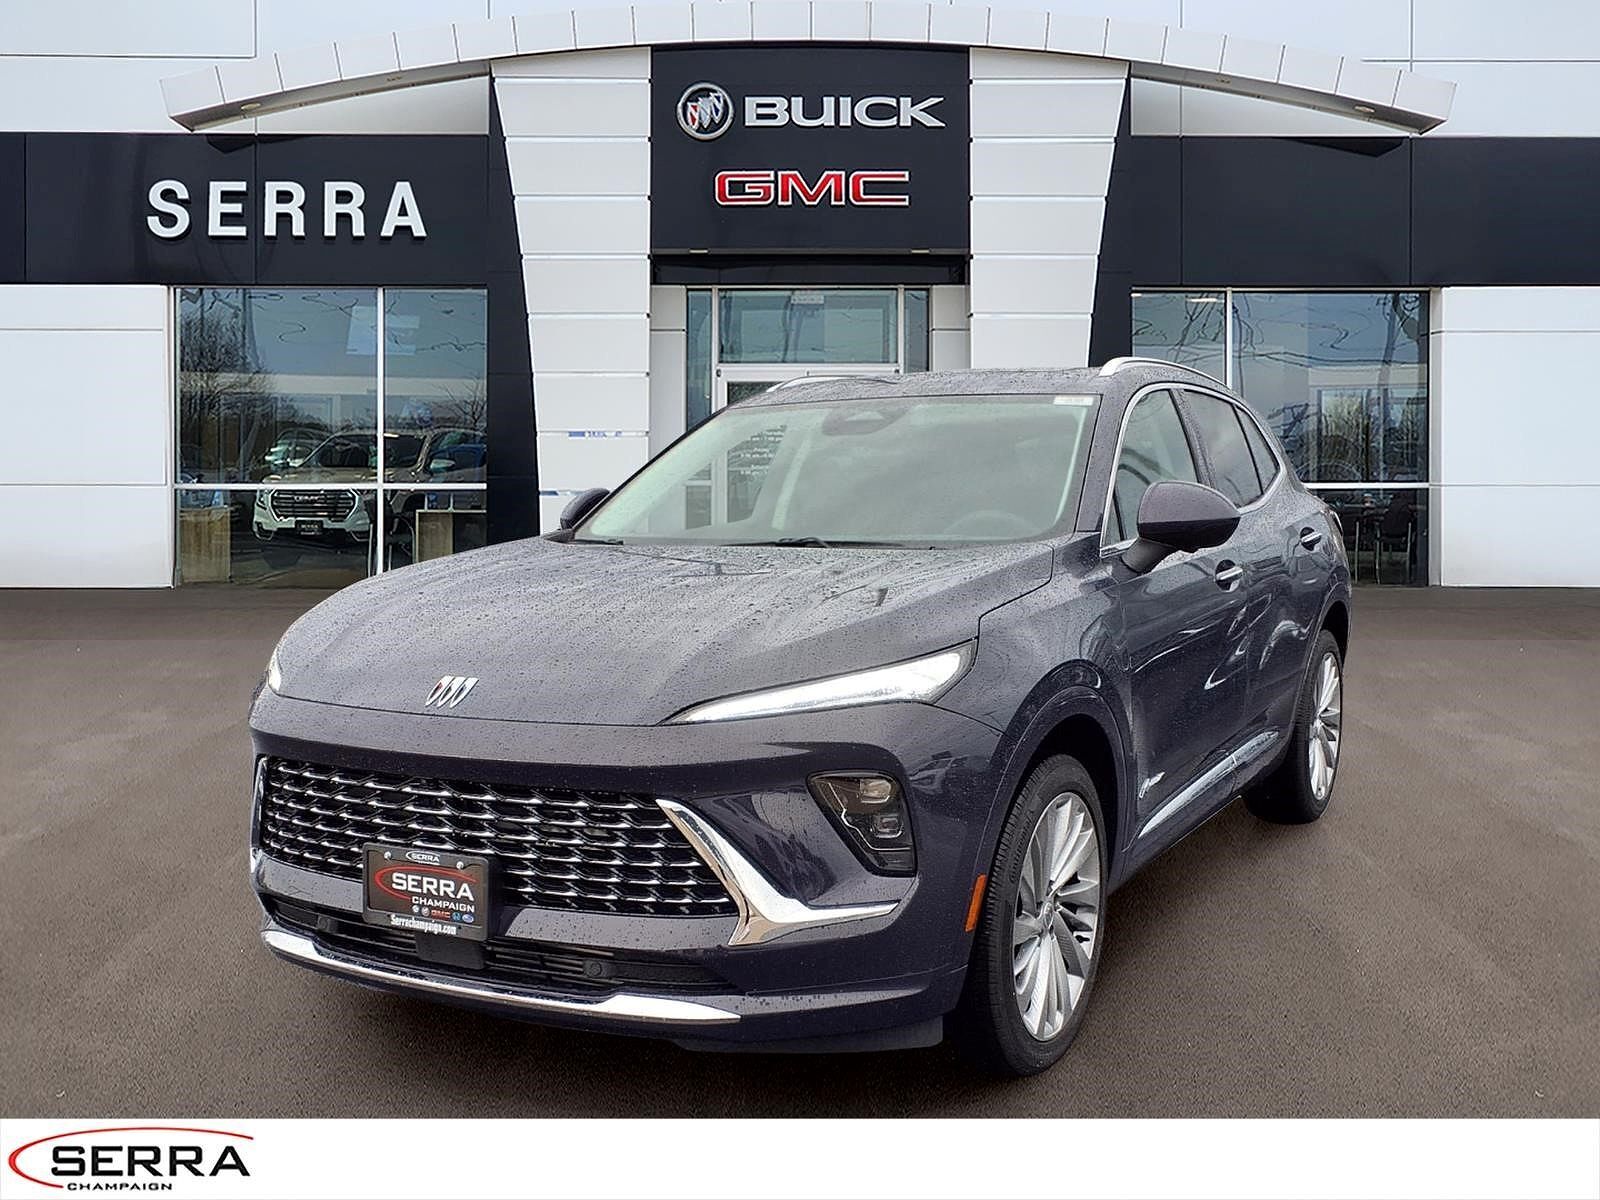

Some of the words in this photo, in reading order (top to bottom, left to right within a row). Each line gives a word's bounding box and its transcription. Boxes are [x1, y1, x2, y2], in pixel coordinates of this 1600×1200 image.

[744, 96, 946, 128] BUICK
[715, 170, 910, 206] GMC
[147, 179, 428, 239] SERRA
[411, 852, 440, 862] SERRA
[392, 872, 474, 901] SERRA
[412, 896, 475, 913] CHAMPAIGN
